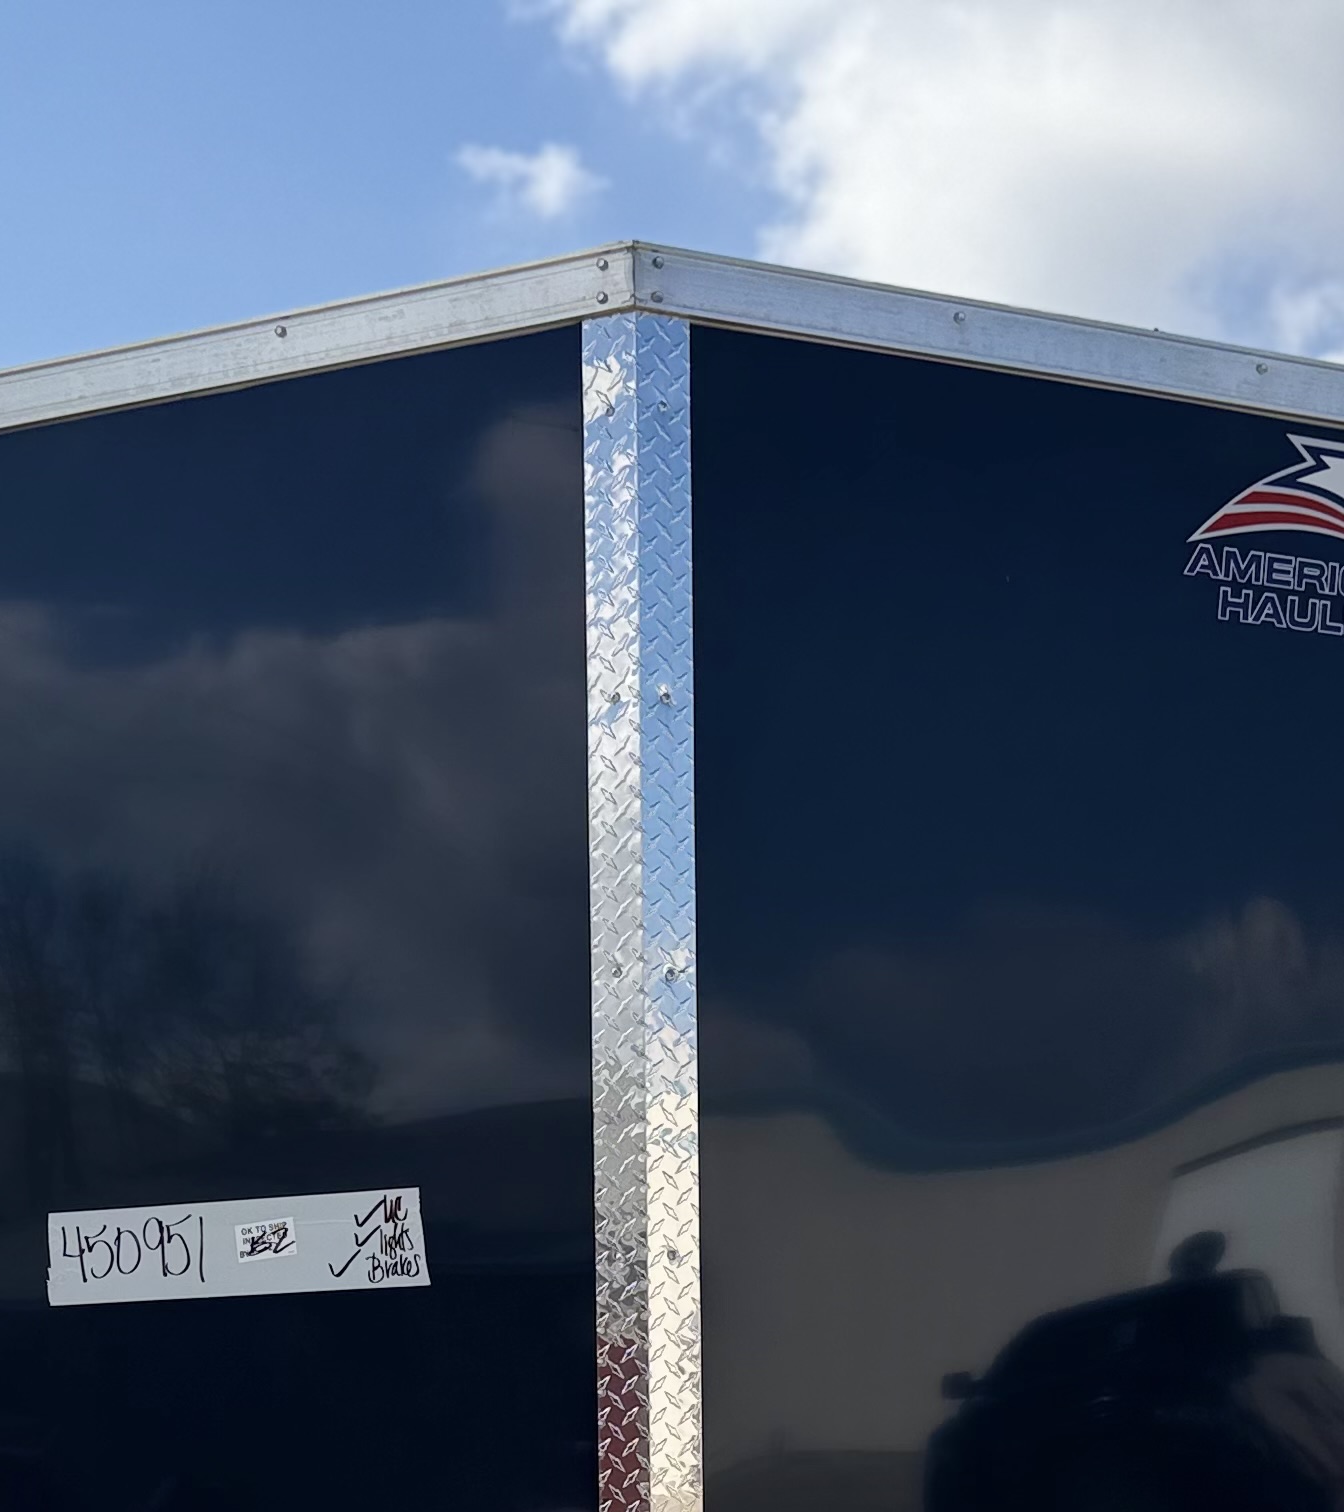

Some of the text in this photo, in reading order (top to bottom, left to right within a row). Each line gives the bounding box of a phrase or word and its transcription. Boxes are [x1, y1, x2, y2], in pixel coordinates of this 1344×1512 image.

[241, 1227, 253, 1235] OK
[255, 1225, 266, 1233] TO
[61, 1214, 205, 1283] 450951
[365, 1252, 421, 1284] Brakes
